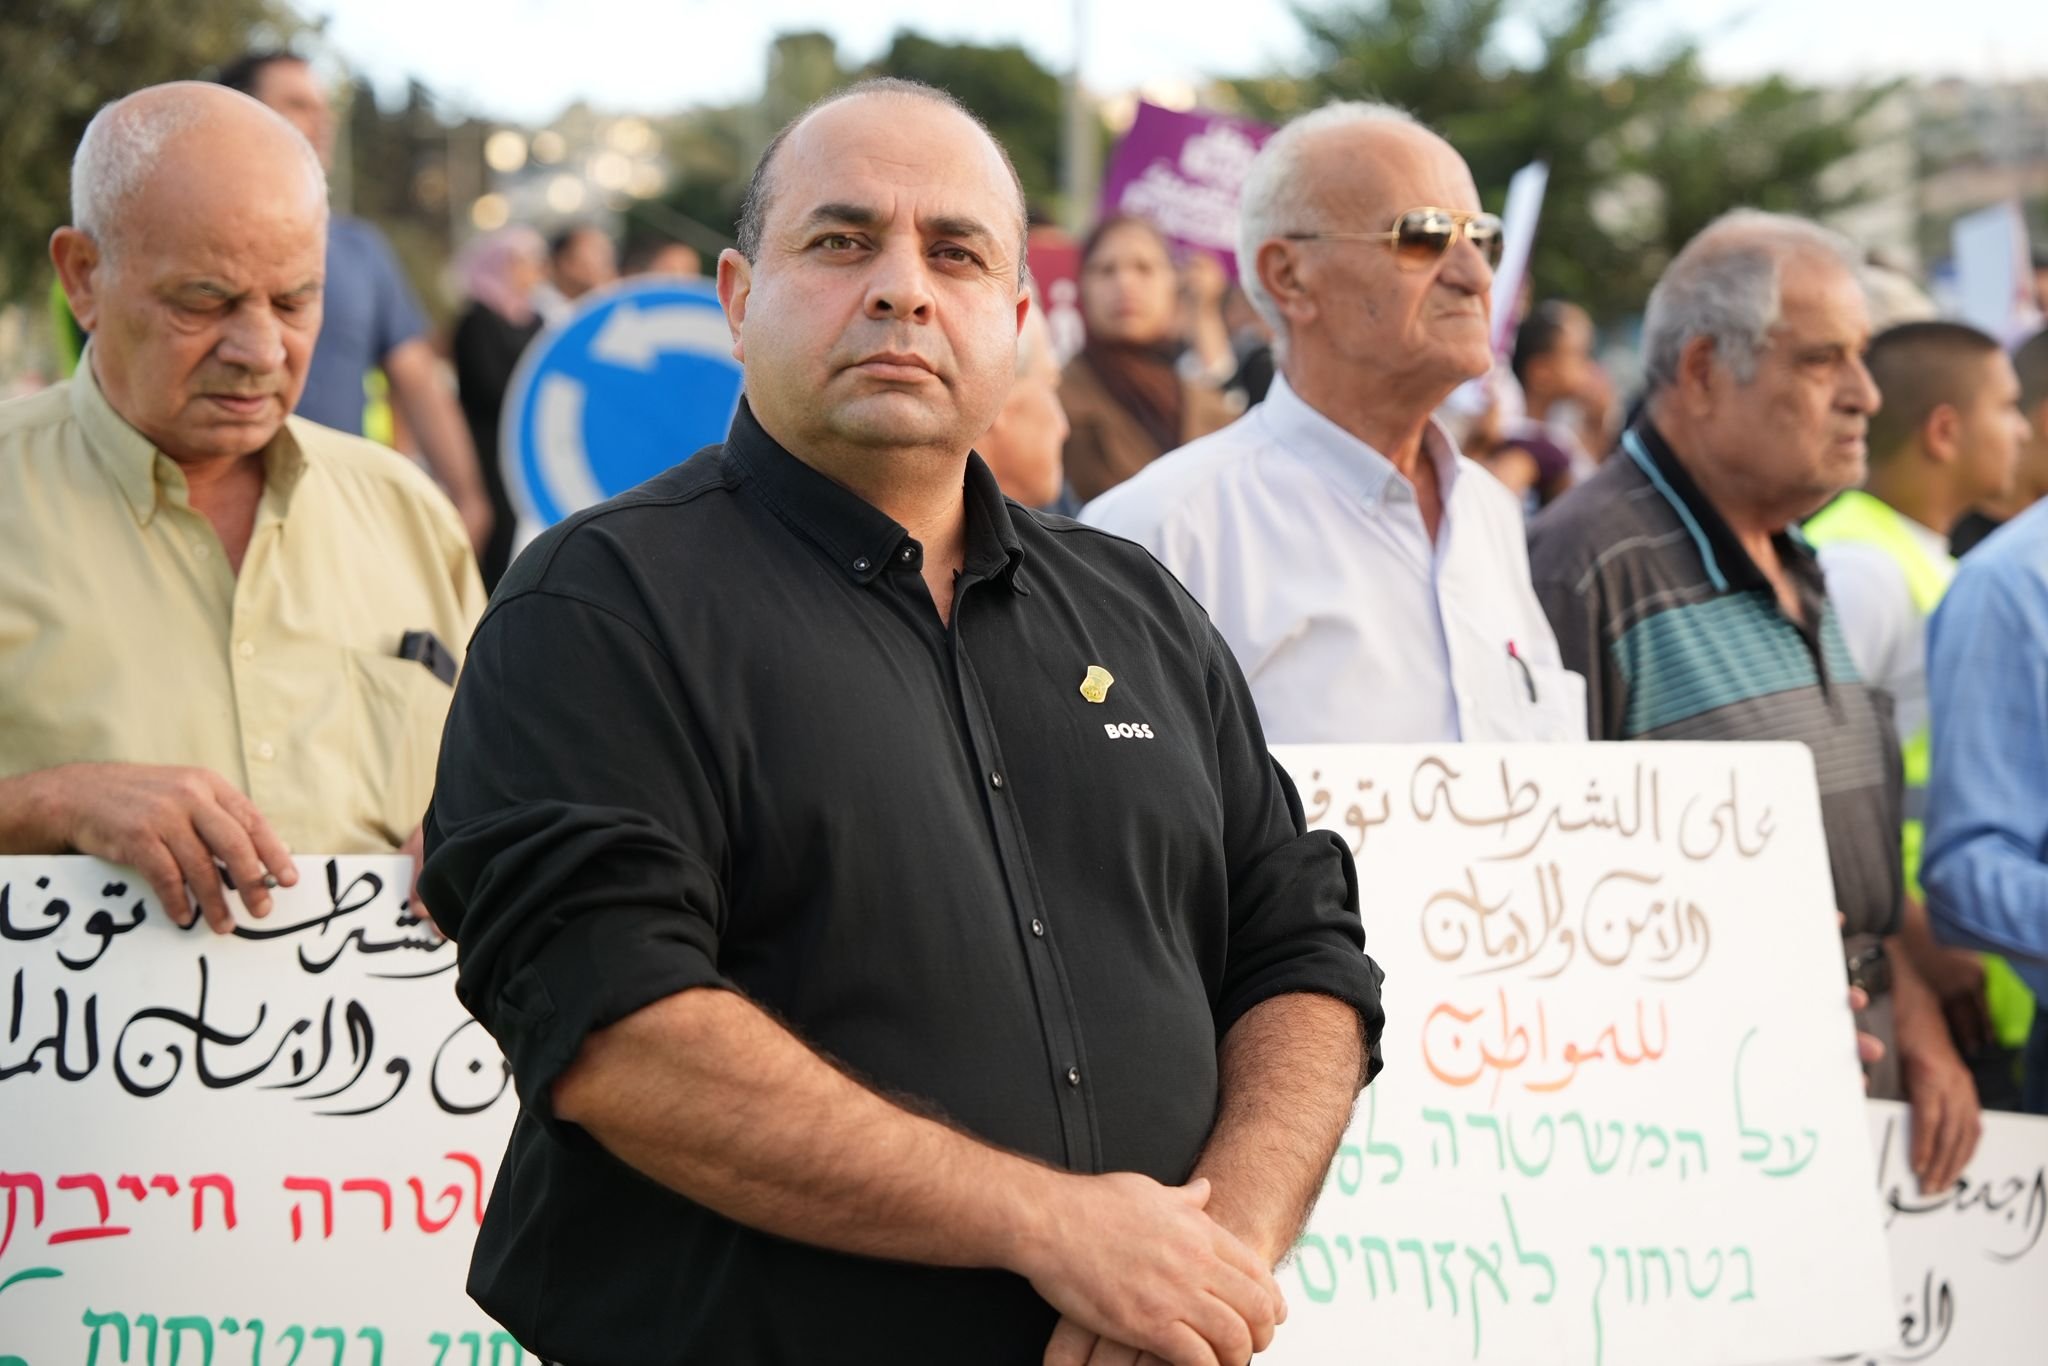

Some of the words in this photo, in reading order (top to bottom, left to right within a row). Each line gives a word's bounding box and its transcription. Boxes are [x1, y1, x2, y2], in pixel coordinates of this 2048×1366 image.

[1104, 722, 1154, 739] BOSS
[1678, 766, 1776, 861] على
[1421, 1105, 1709, 1181] המשטרה
[1735, 1026, 1818, 1178] על
